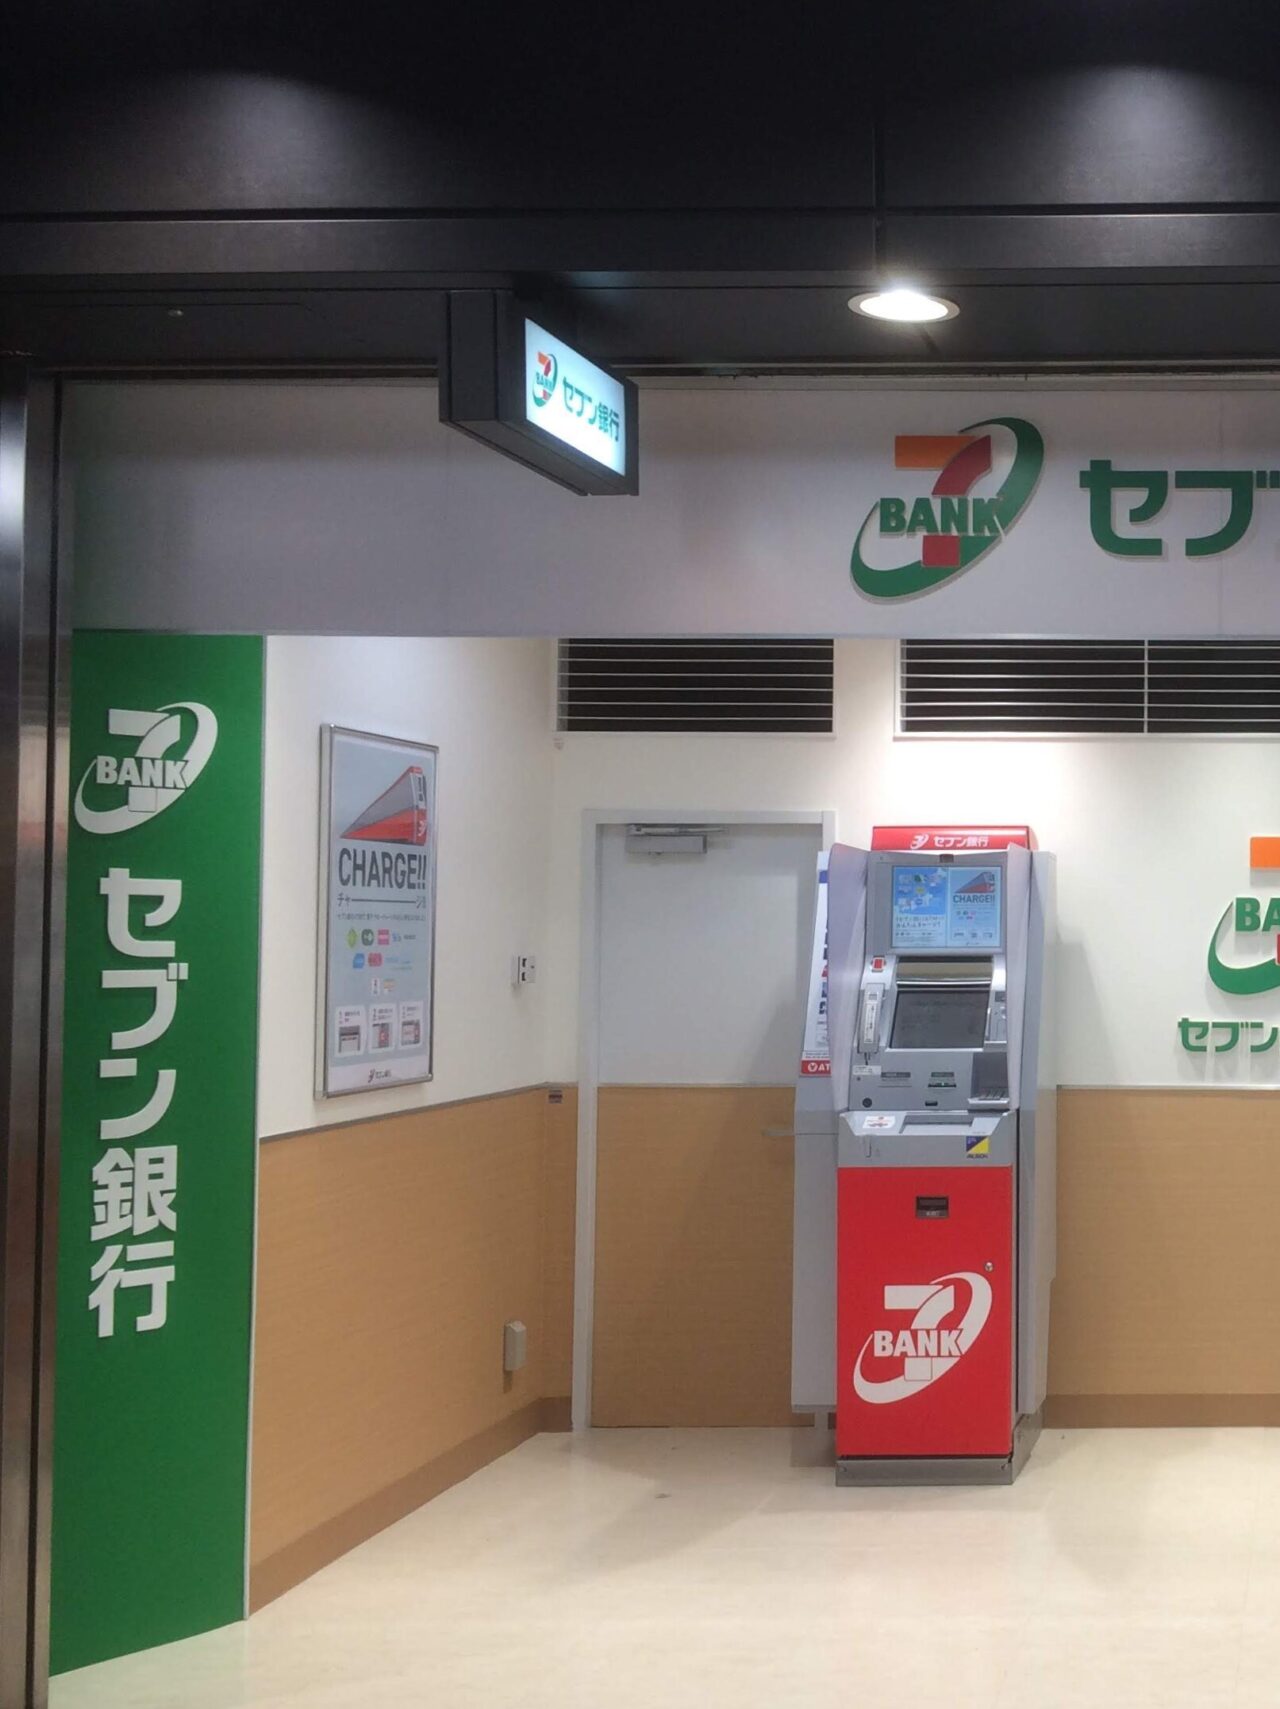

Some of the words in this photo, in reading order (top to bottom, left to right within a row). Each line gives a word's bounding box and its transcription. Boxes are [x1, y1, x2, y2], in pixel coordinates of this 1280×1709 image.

[563, 377, 619, 442] セブン銀行
[880, 497, 1002, 537] BANK
[96, 755, 187, 790] BANK
[338, 847, 427, 890] CHARGE!!
[818, 1063, 831, 1071] AT
[88, 867, 189, 1338] セブン銀行
[873, 1330, 962, 1357] BANK
